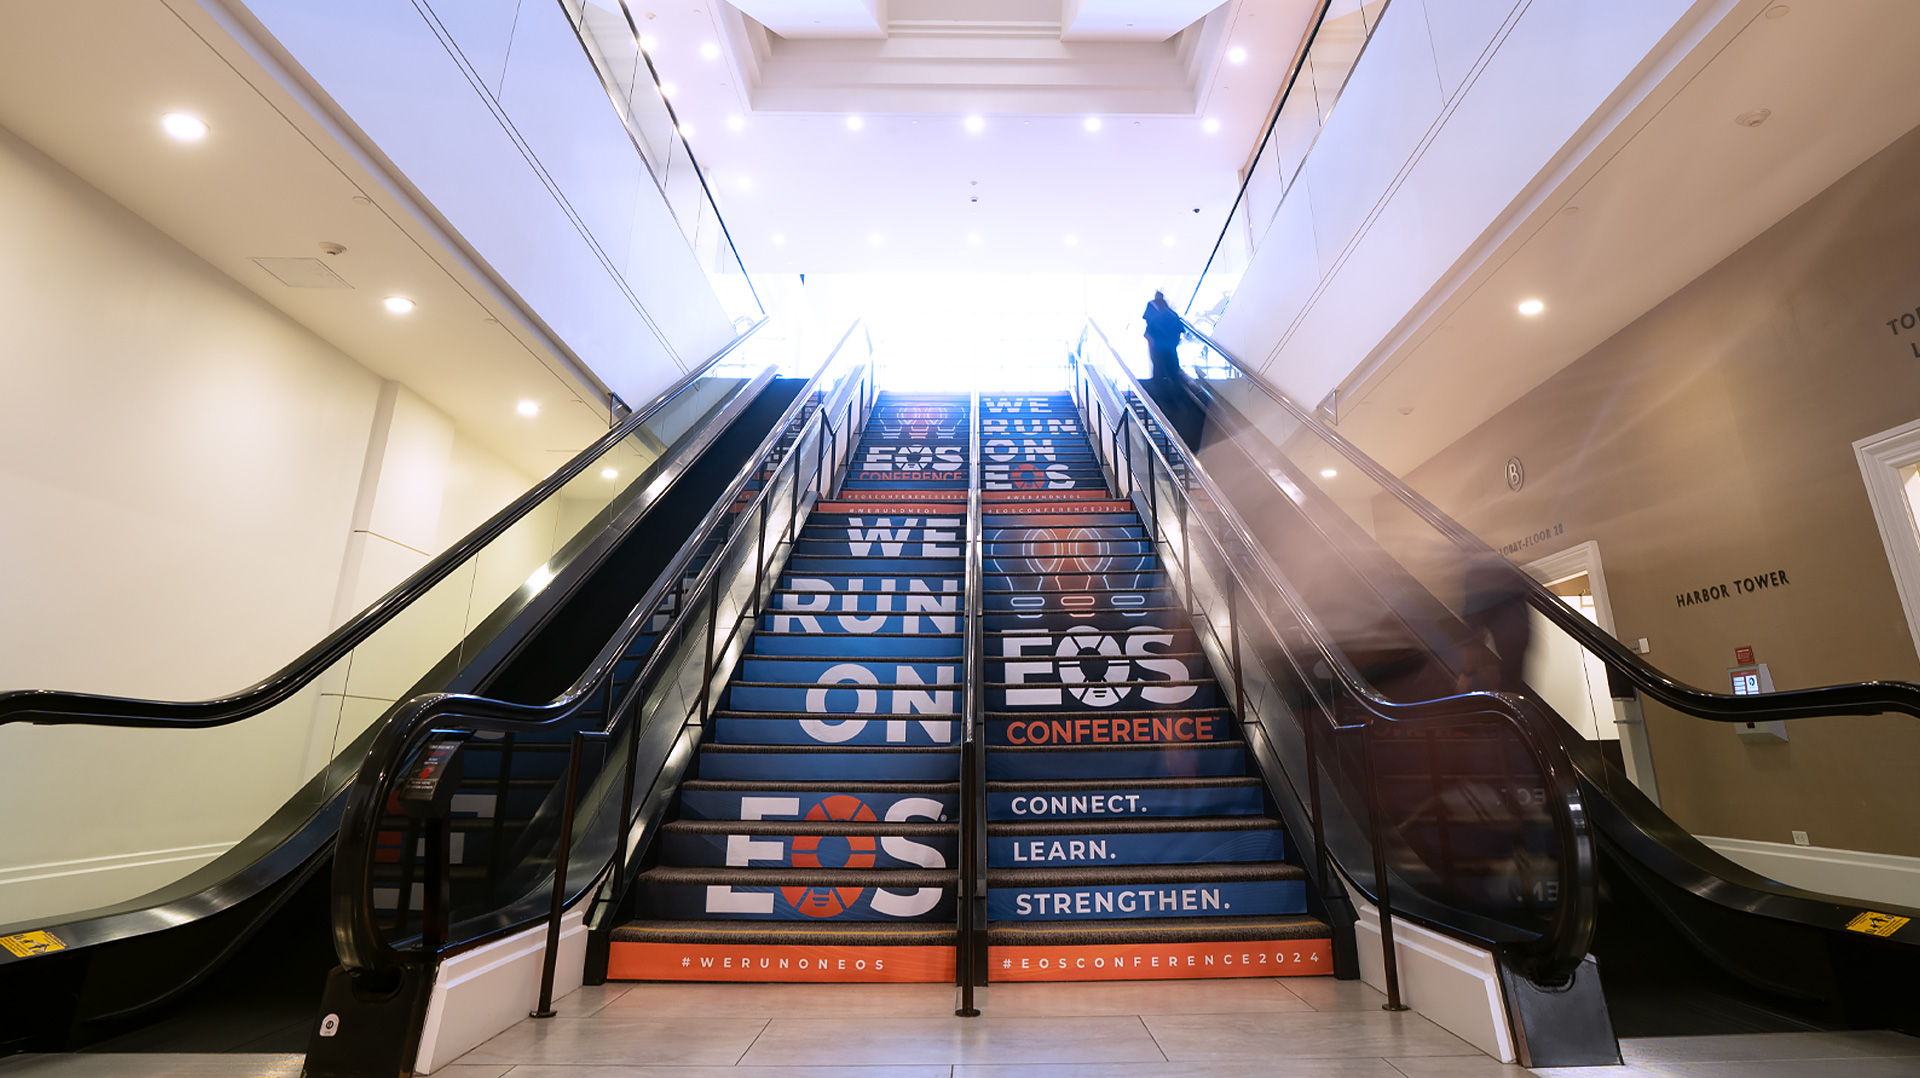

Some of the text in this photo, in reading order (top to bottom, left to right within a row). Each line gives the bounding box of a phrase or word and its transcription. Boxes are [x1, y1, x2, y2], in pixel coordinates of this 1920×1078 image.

[983, 398, 1052, 412] WE
[983, 419, 1078, 435] RUN
[863, 444, 964, 471] EOS
[985, 439, 1056, 462] ON
[985, 464, 1075, 489] EOS
[847, 518, 960, 557] WE
[1676, 570, 1790, 608] HARBOR TOWER
[773, 578, 958, 634] RUN
[1001, 625, 1198, 707] EOS
[798, 663, 954, 743] ON
[1011, 795, 1147, 815] CONNECT.
[706, 795, 946, 918] EOS
[1013, 840, 1117, 862] LEARN.
[1016, 889, 1231, 916] STRENGTHEN.
[681, 957, 885, 970] #WERUNONEOS
[1003, 952, 1319, 970] #EOSCONFERENCE2024
